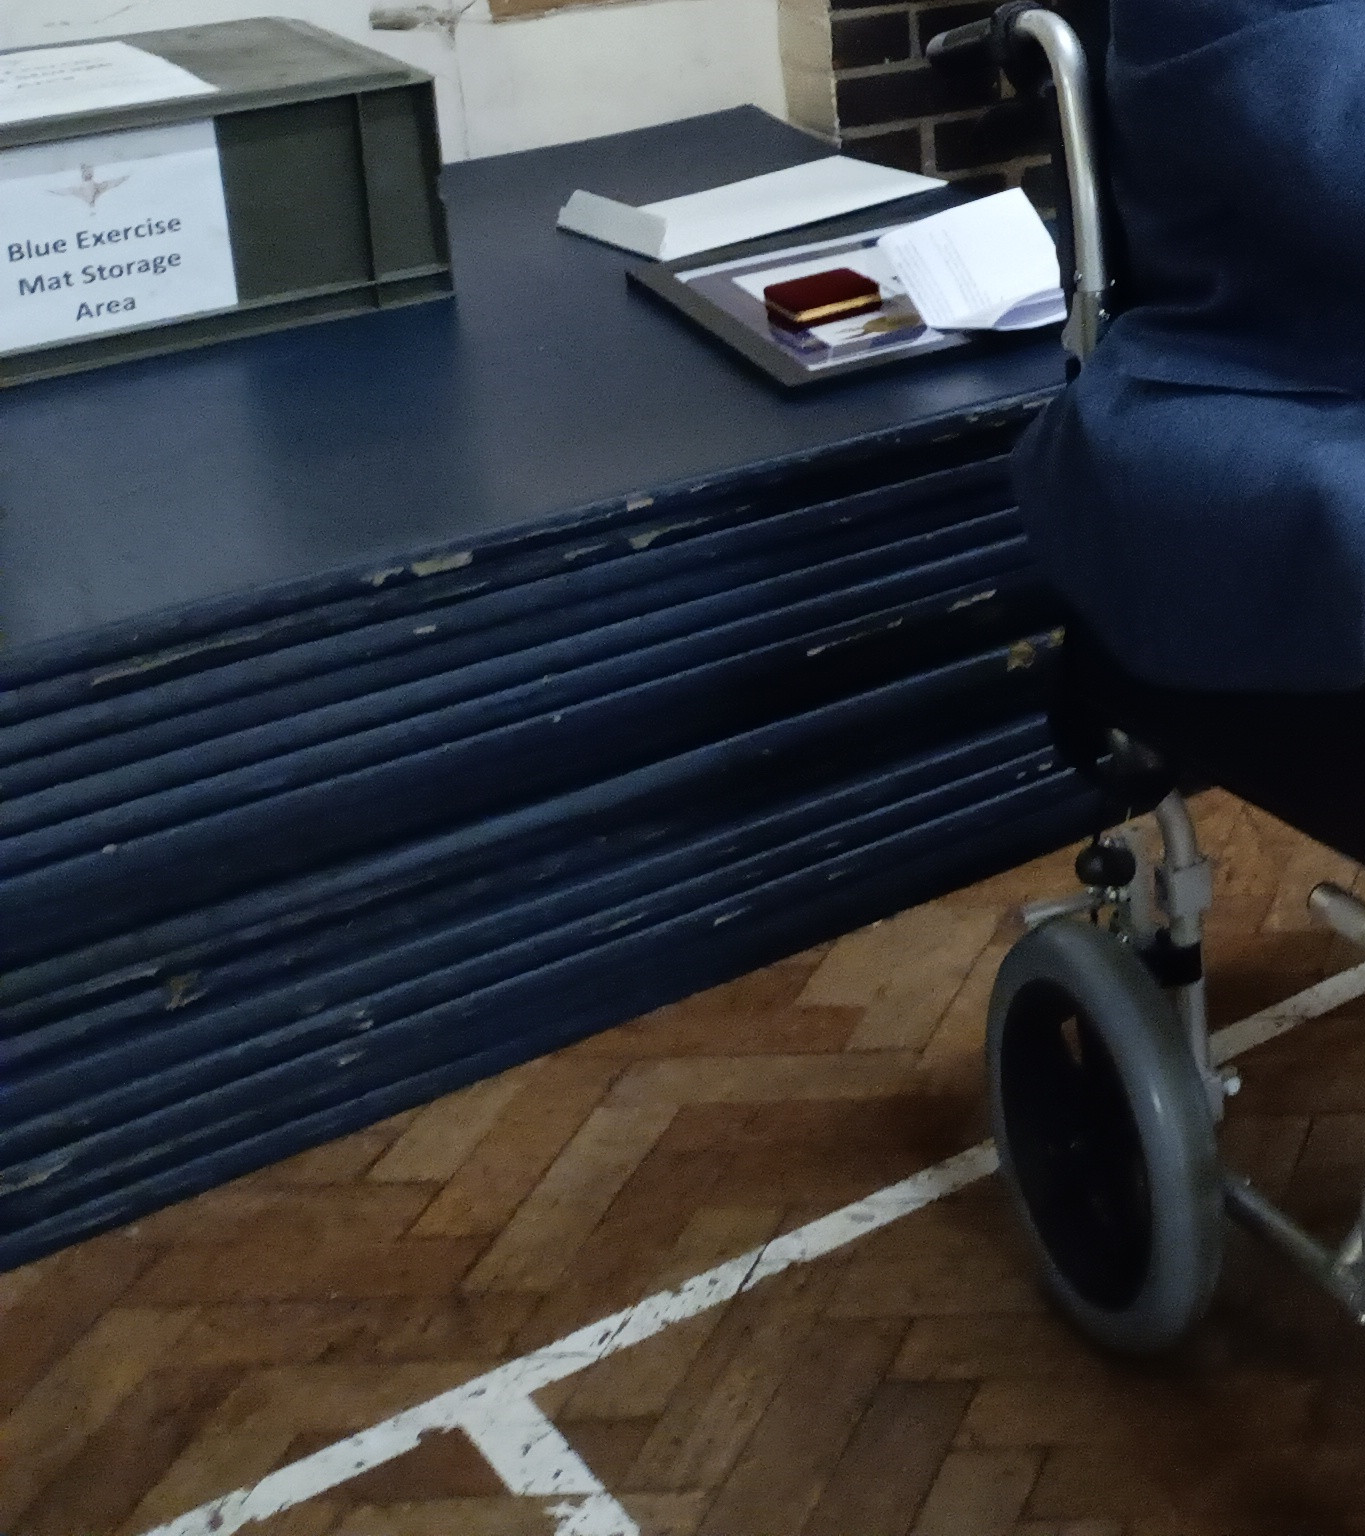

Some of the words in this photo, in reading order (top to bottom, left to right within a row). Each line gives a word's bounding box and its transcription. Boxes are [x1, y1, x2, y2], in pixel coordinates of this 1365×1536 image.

[7, 238, 67, 263] Blue
[76, 217, 182, 250] Exercise
[18, 270, 75, 296] Mat
[81, 253, 182, 285] Storage
[76, 296, 136, 322] Area
